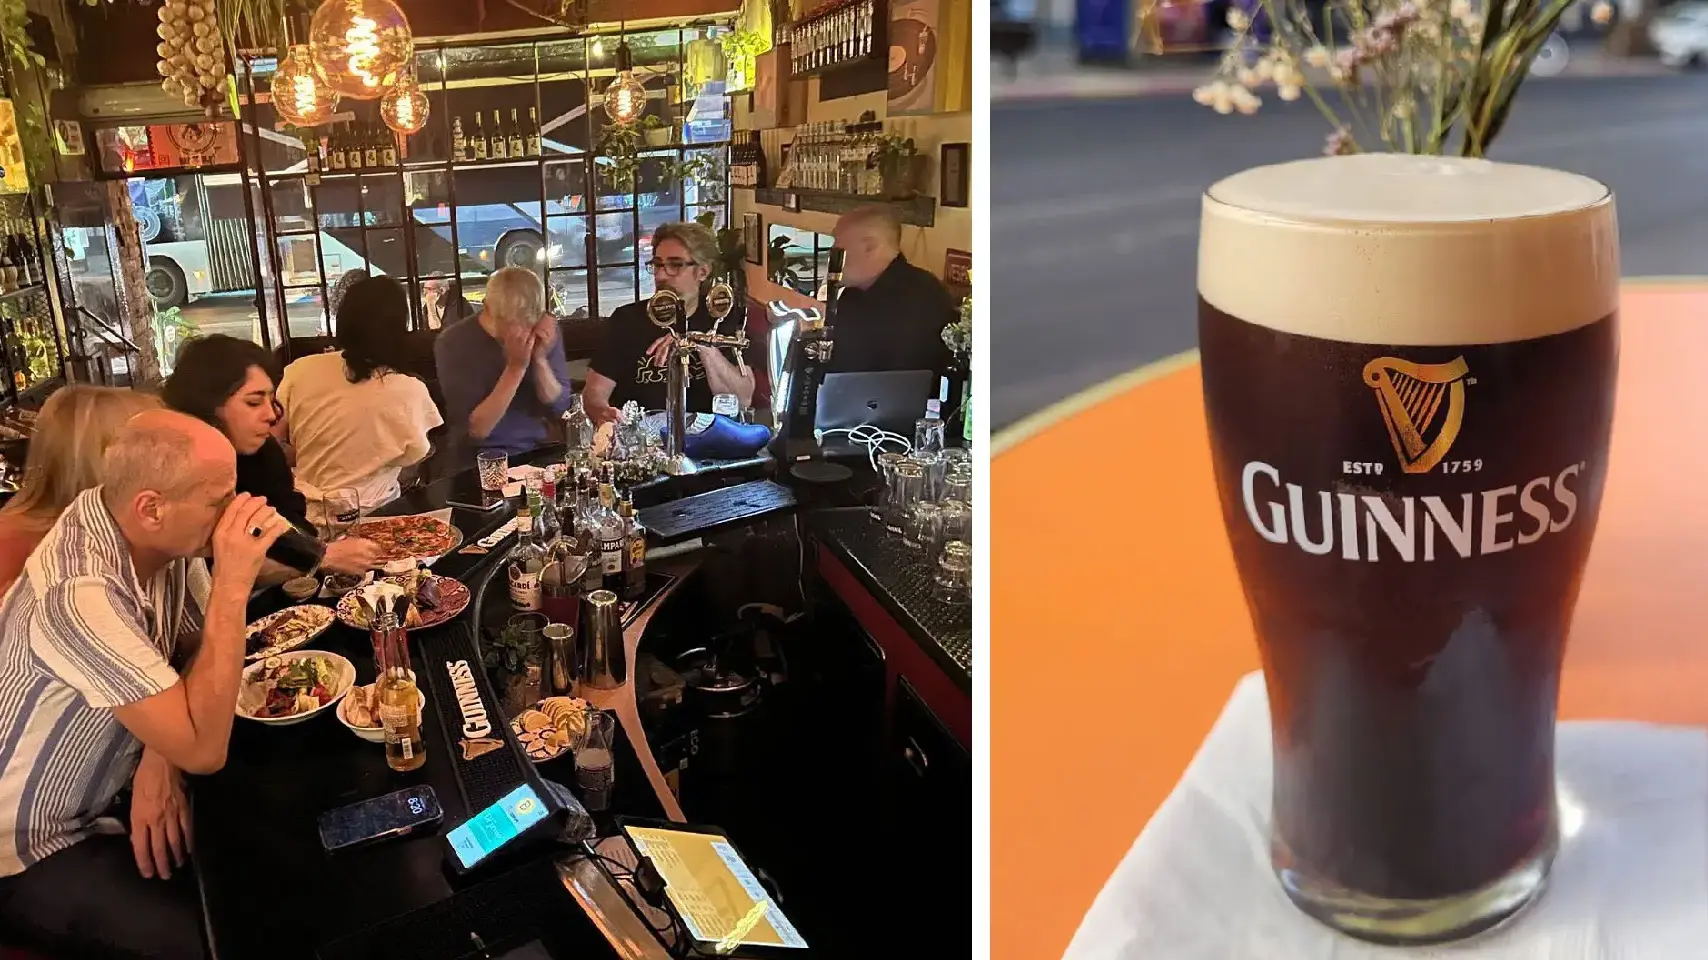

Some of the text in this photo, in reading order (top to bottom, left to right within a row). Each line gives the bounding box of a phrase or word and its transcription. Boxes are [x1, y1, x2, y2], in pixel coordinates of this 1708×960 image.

[1442, 458, 1483, 474] 1759
[1242, 461, 1579, 562] GUINNESS
[446, 660, 492, 739] GUINNESS
[407, 797, 422, 814] 8:20
